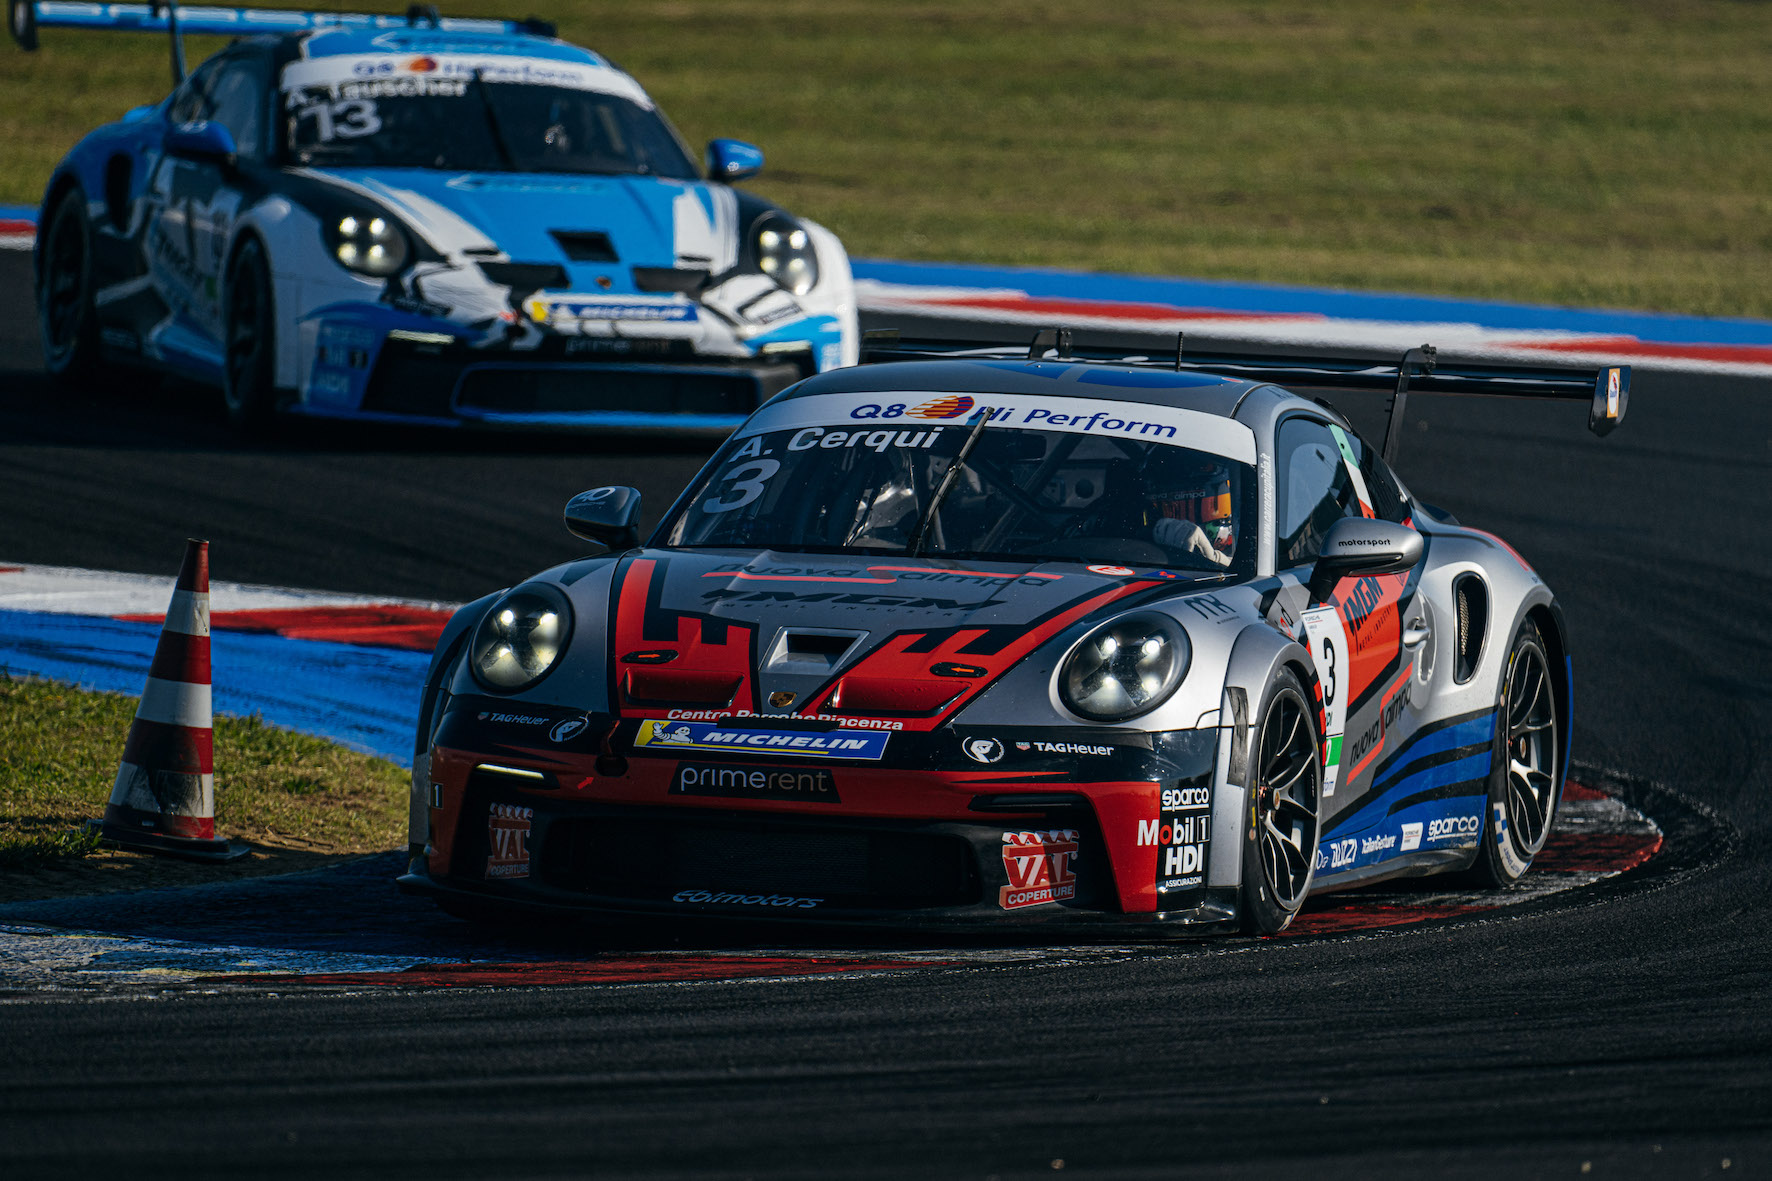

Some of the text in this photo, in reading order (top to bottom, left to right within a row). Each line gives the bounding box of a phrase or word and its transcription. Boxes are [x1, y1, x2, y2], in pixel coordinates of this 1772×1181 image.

[299, 99, 382, 142] 13
[850, 403, 906, 419] Q8
[1022, 408, 1178, 438] Perform
[728, 427, 944, 463] A. Cerqui
[702, 458, 781, 514] 3
[1338, 538, 1391, 547] motorsport
[1323, 637, 1336, 706] 3
[667, 708, 731, 720] Centro
[702, 732, 869, 750] MICHELIN
[681, 767, 829, 792] primerent
[1162, 787, 1210, 812] sparco
[1137, 817, 1194, 846] Mobil
[1427, 815, 1479, 842] sparco
[1003, 852, 1077, 889] VAL
[1165, 843, 1204, 876] HDI
[1008, 885, 1073, 904] COPERTURE
